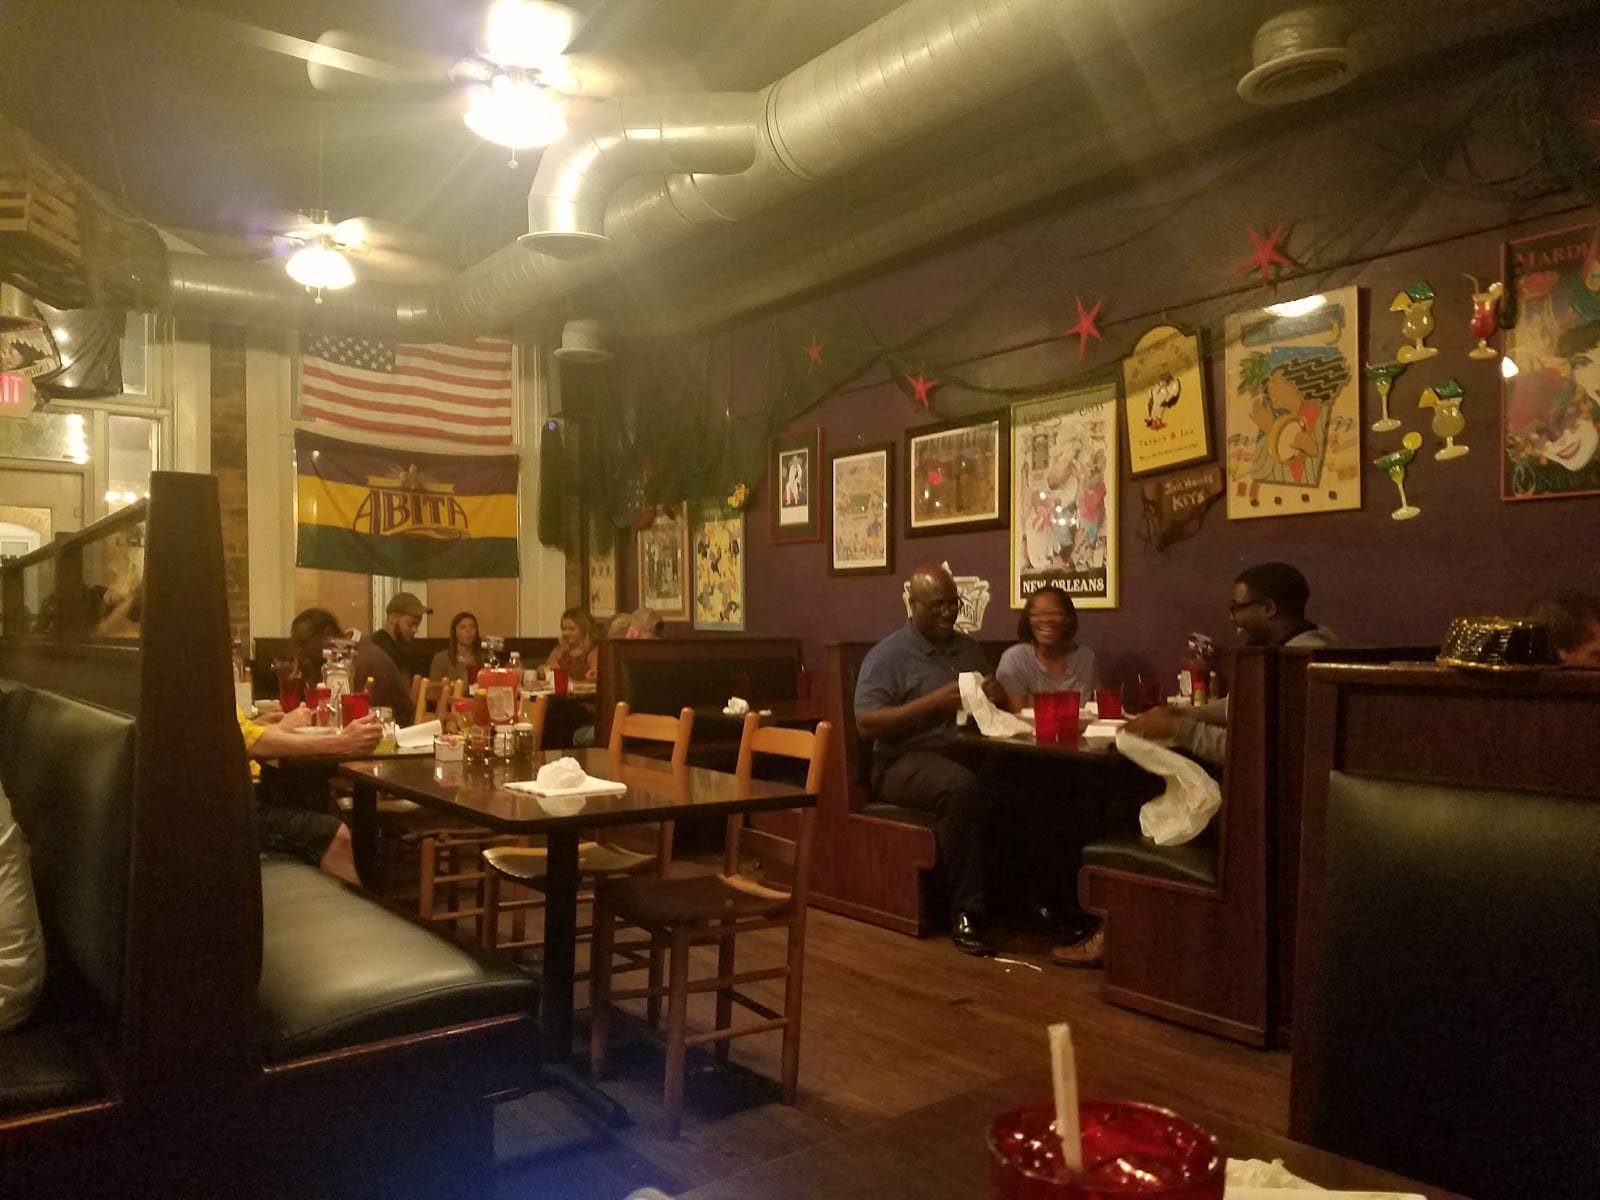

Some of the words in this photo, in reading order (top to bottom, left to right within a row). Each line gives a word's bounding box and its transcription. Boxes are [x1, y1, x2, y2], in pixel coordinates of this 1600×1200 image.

[0, 374, 23, 403] IT
[352, 488, 469, 536] ABITA
[1022, 579, 1047, 594] NEW
[1050, 577, 1105, 593] ORLEANS
